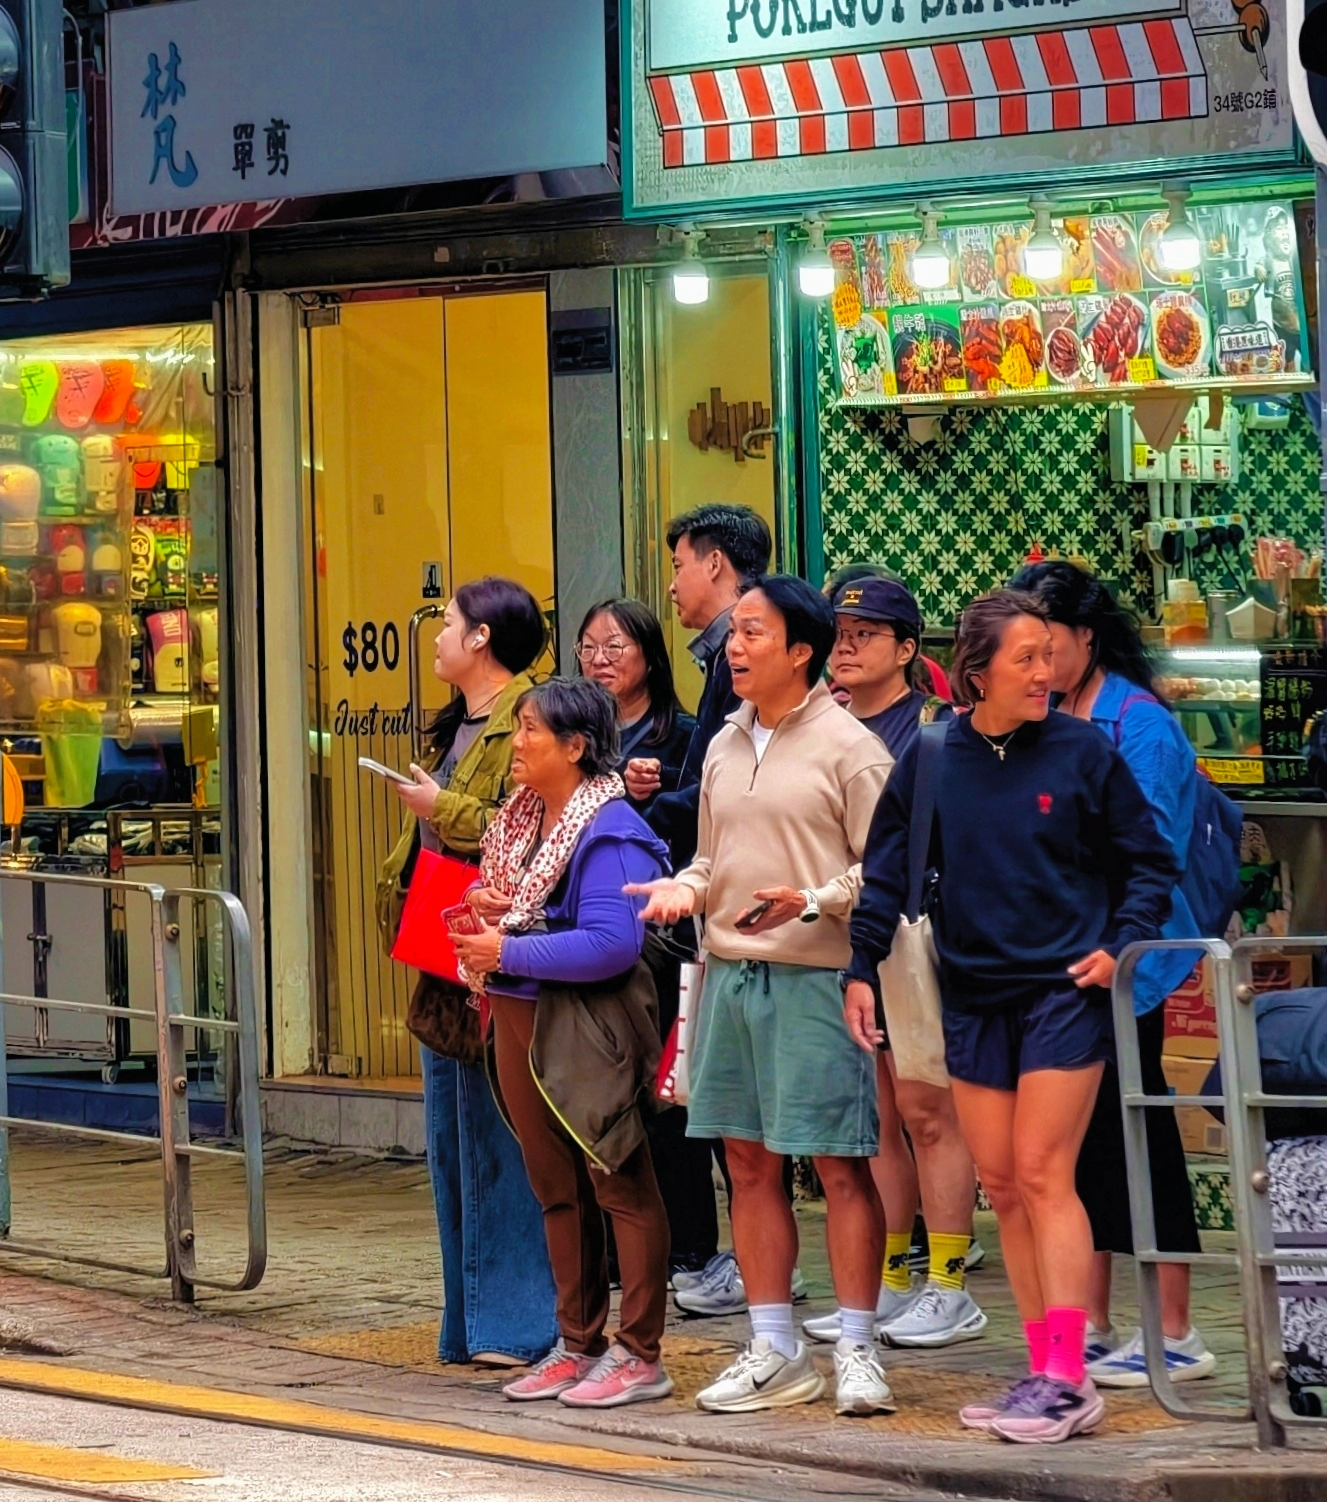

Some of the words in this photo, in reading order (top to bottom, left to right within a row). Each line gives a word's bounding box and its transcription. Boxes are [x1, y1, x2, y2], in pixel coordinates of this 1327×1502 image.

[342, 621, 400, 677] $80
[335, 699, 378, 736] Just
[381, 703, 413, 735] cut
